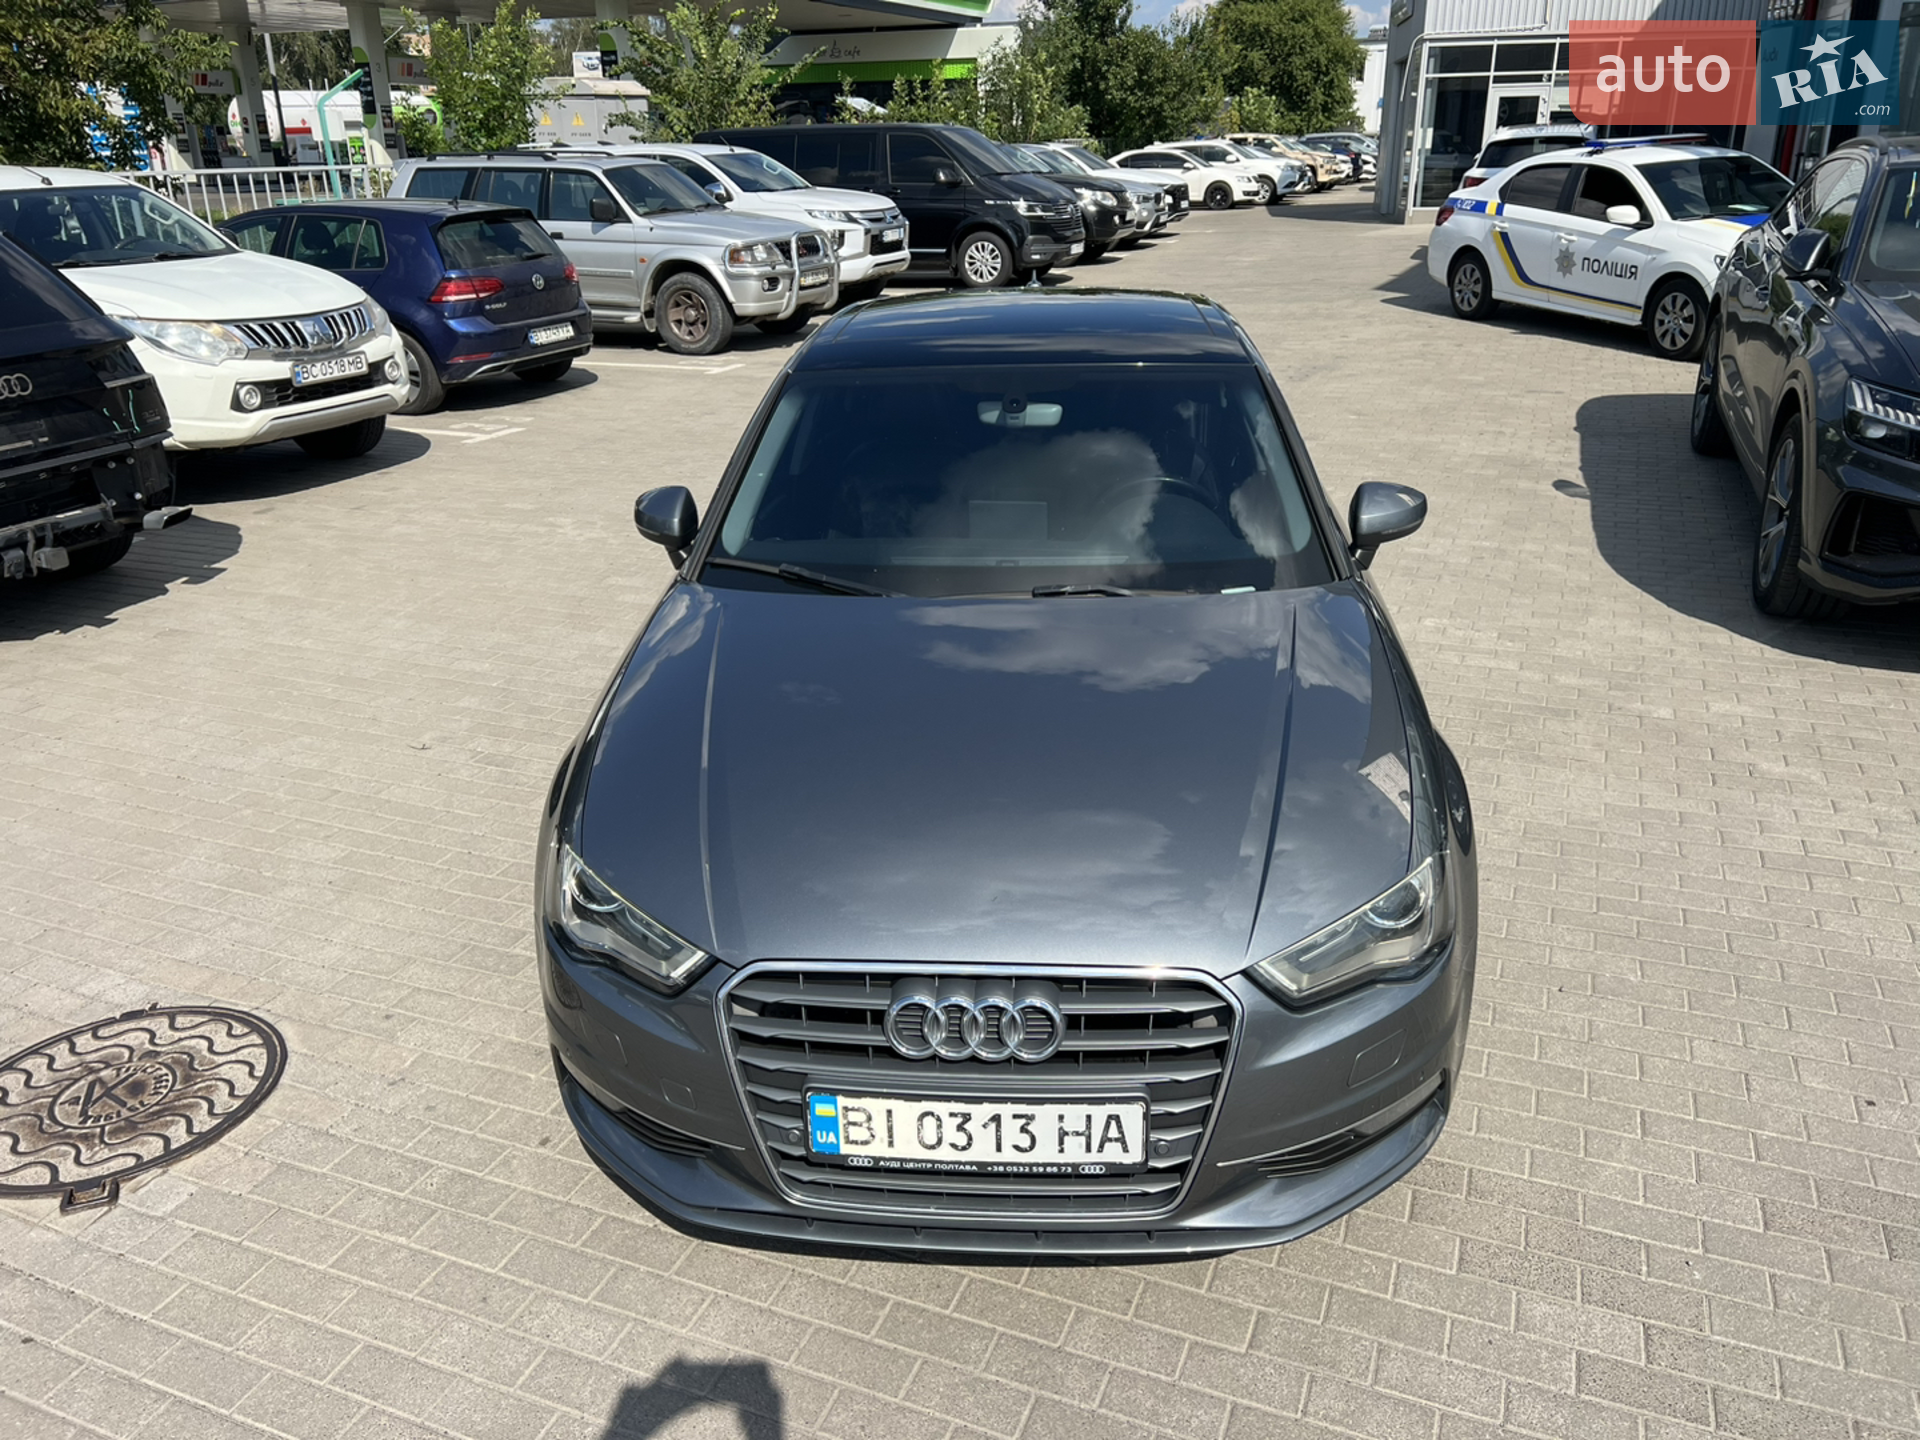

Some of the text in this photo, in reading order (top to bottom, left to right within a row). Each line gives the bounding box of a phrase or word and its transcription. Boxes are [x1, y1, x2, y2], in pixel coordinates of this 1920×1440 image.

[1580, 256, 1639, 281] ПОЛІЦІЯ
[300, 355, 364, 380] BC 0518 MB
[816, 1130, 838, 1144] UA
[842, 1105, 1130, 1154] BI 0313 HA
[879, 1159, 978, 1171] АУДІ ЦЕНТР ПОЛТАВА
[1006, 1165, 1030, 1173] 0532
